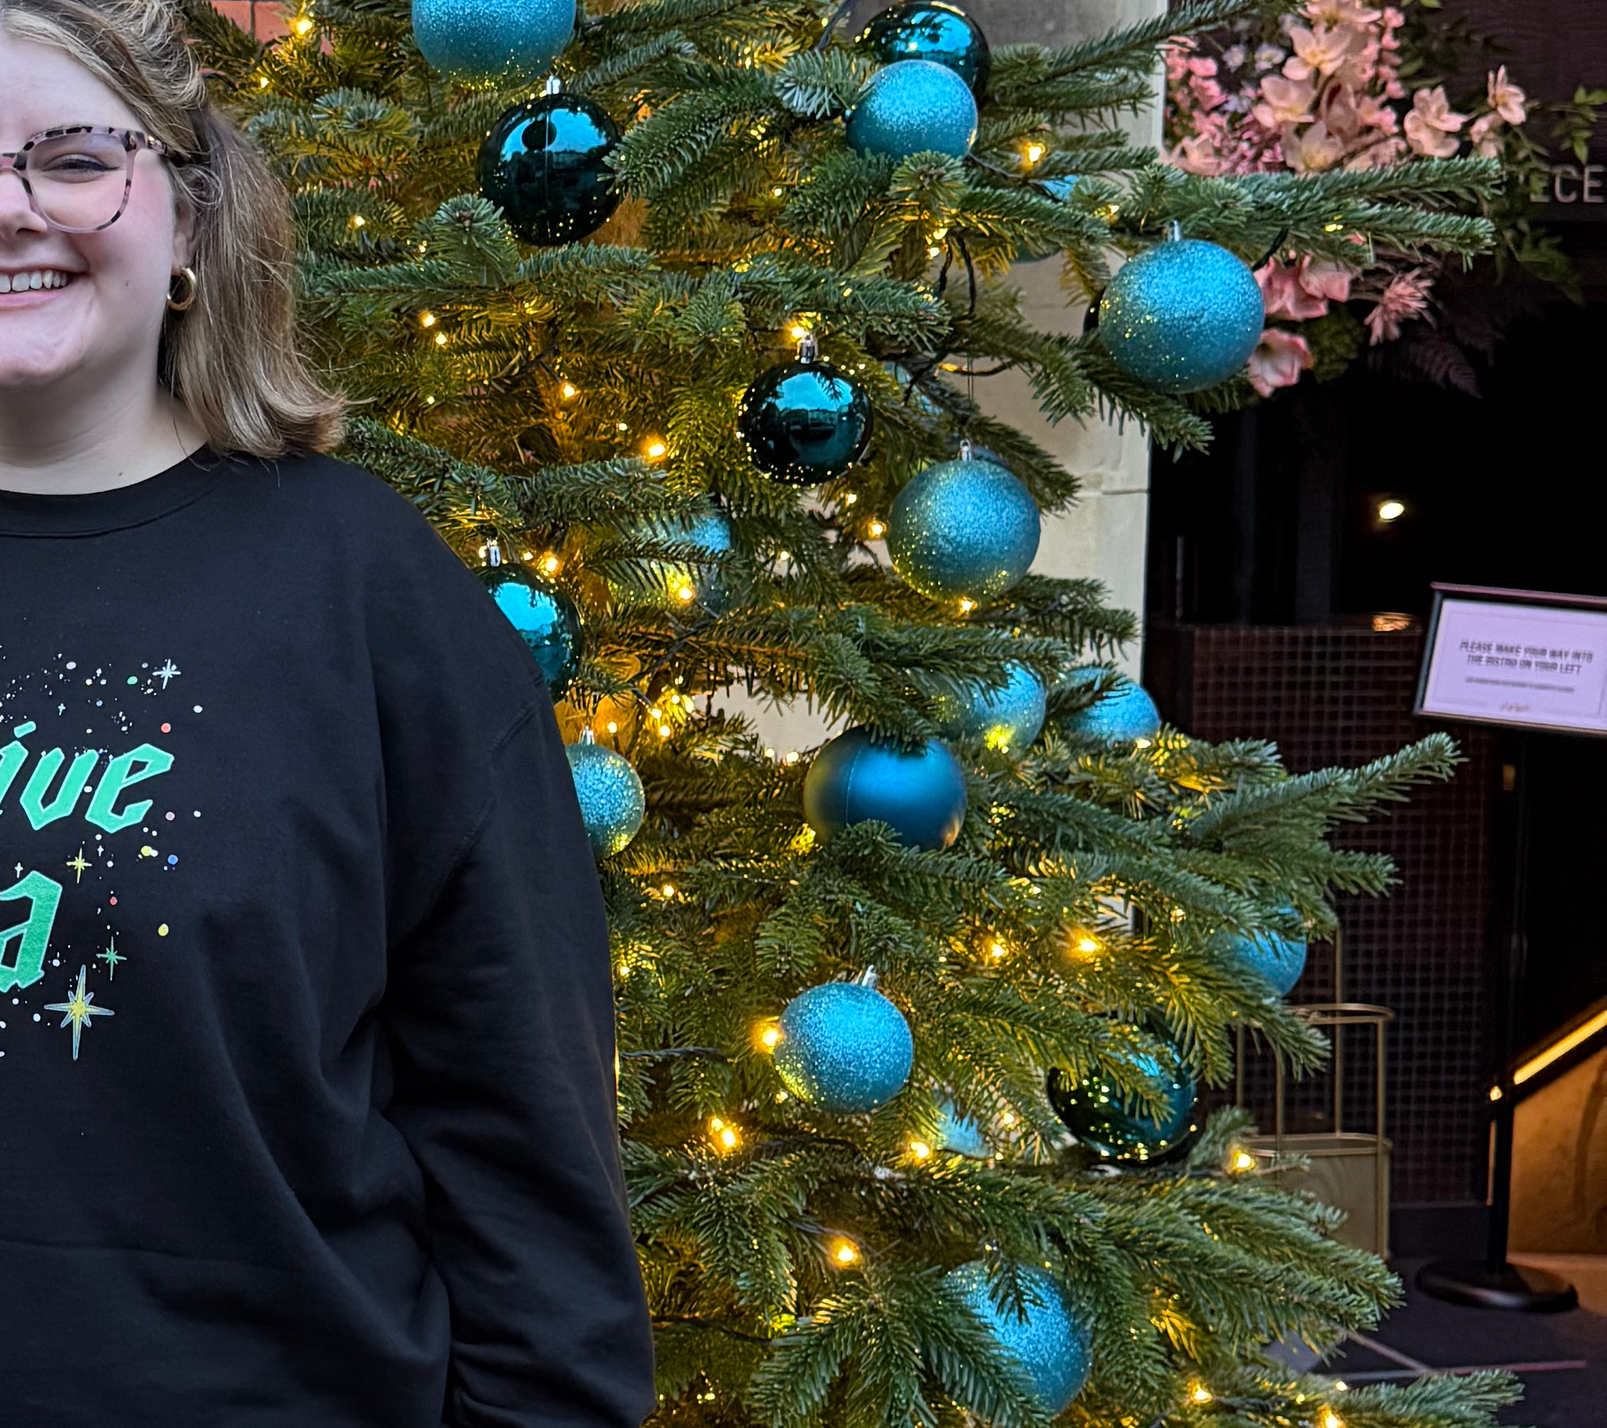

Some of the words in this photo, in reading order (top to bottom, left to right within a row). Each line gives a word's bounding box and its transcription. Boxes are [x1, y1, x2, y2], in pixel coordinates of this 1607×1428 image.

[1460, 639, 1492, 653] PLEASE
[1496, 641, 1522, 654] MAKE
[1524, 645, 1547, 657] YOUR
[1549, 648, 1569, 659] WAY
[1572, 650, 1593, 662] INTO
[1467, 654, 1483, 664] THE
[1534, 661, 1558, 672] YOUR
[1560, 663, 1582, 674] LEFT
